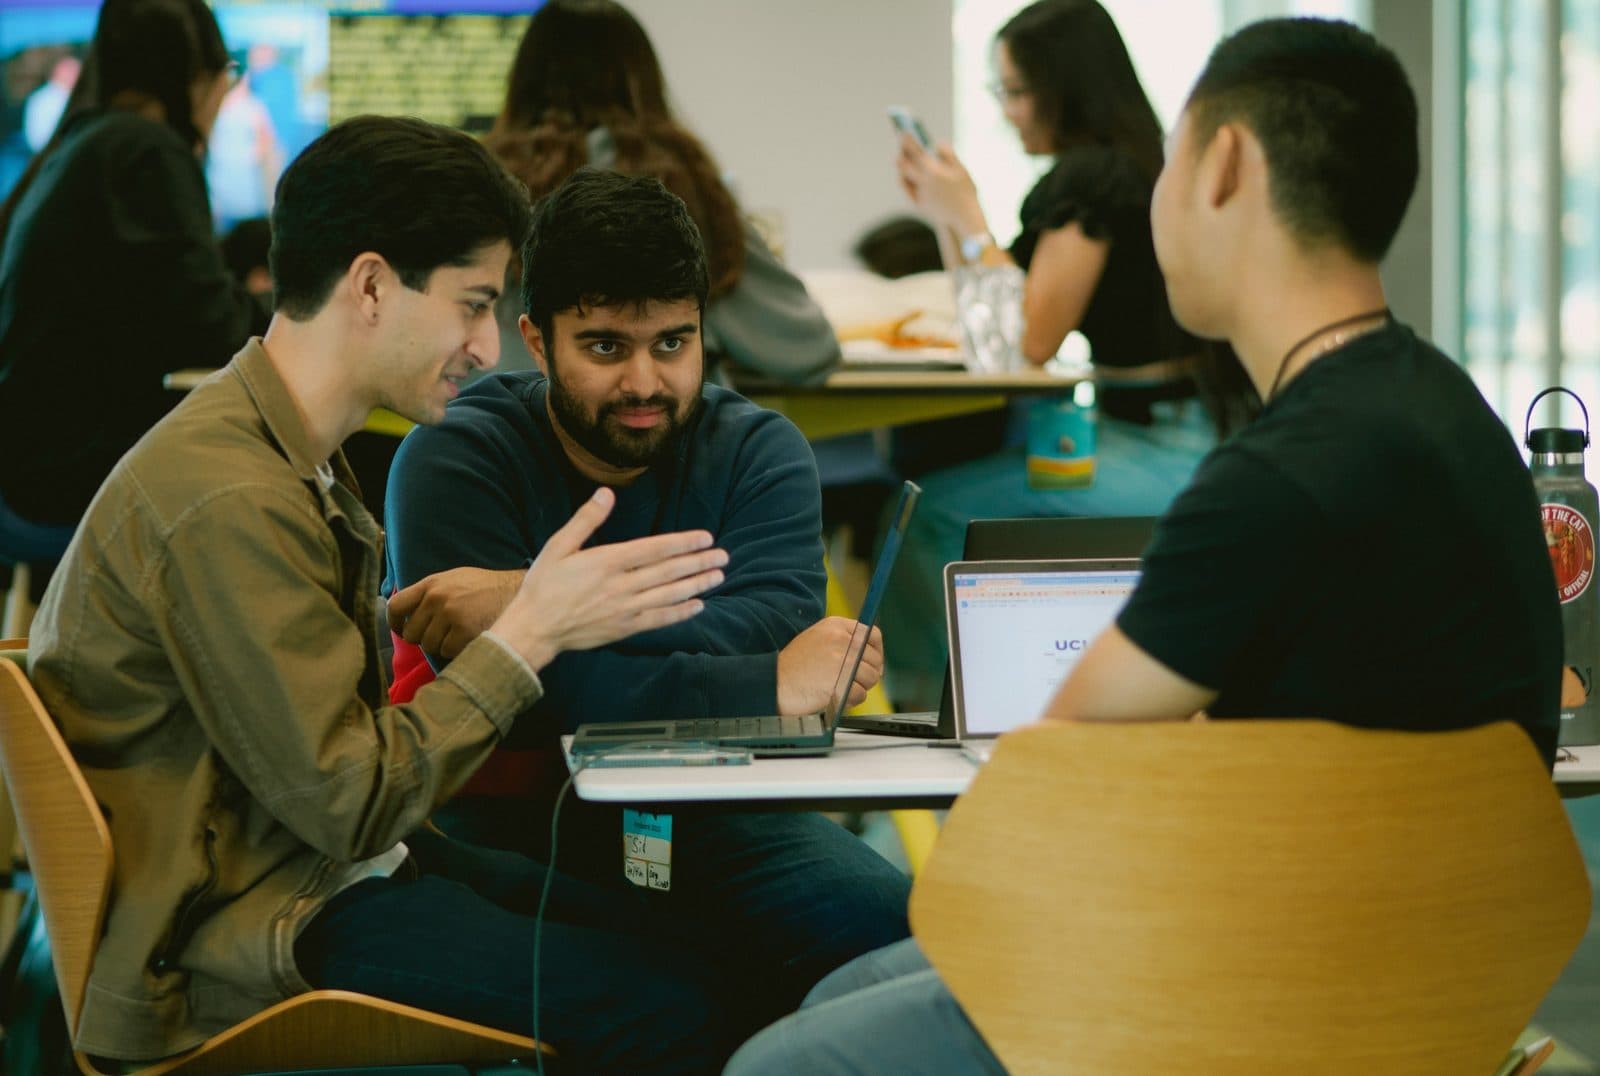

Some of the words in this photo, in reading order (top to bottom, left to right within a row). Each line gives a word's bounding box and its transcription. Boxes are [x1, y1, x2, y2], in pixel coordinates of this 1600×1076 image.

[1552, 509, 1569, 521] THE
[1569, 515, 1585, 531] CAT
[1564, 570, 1589, 596] OFFICIAL
